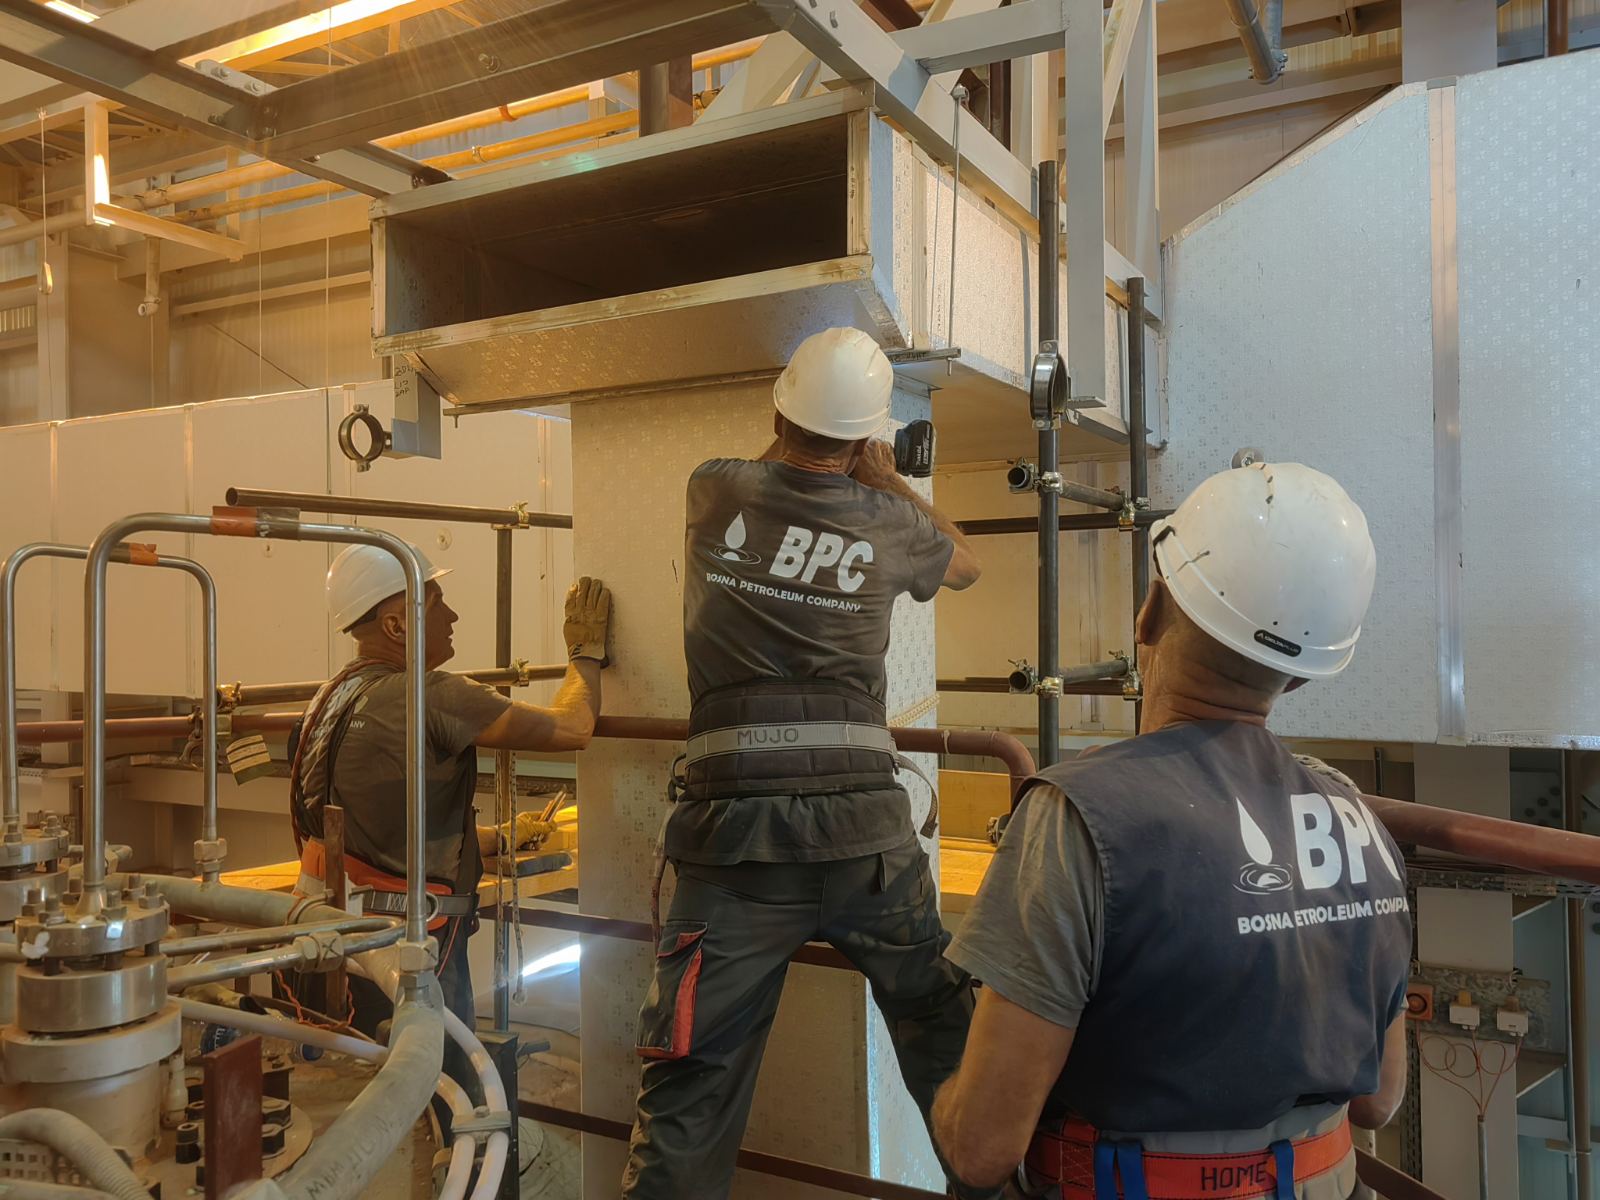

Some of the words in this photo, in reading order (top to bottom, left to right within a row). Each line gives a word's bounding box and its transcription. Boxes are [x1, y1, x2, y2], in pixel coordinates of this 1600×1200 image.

[769, 525, 874, 592] BPC
[740, 581, 804, 602] PETROLEUM
[807, 595, 861, 613] COMPANY
[737, 727, 799, 746] MUJO
[1237, 911, 1294, 935] BOSNA
[1293, 900, 1373, 926] ETROLEUM
[1374, 895, 1410, 916] COMPA
[1201, 1160, 1269, 1191] HOME
